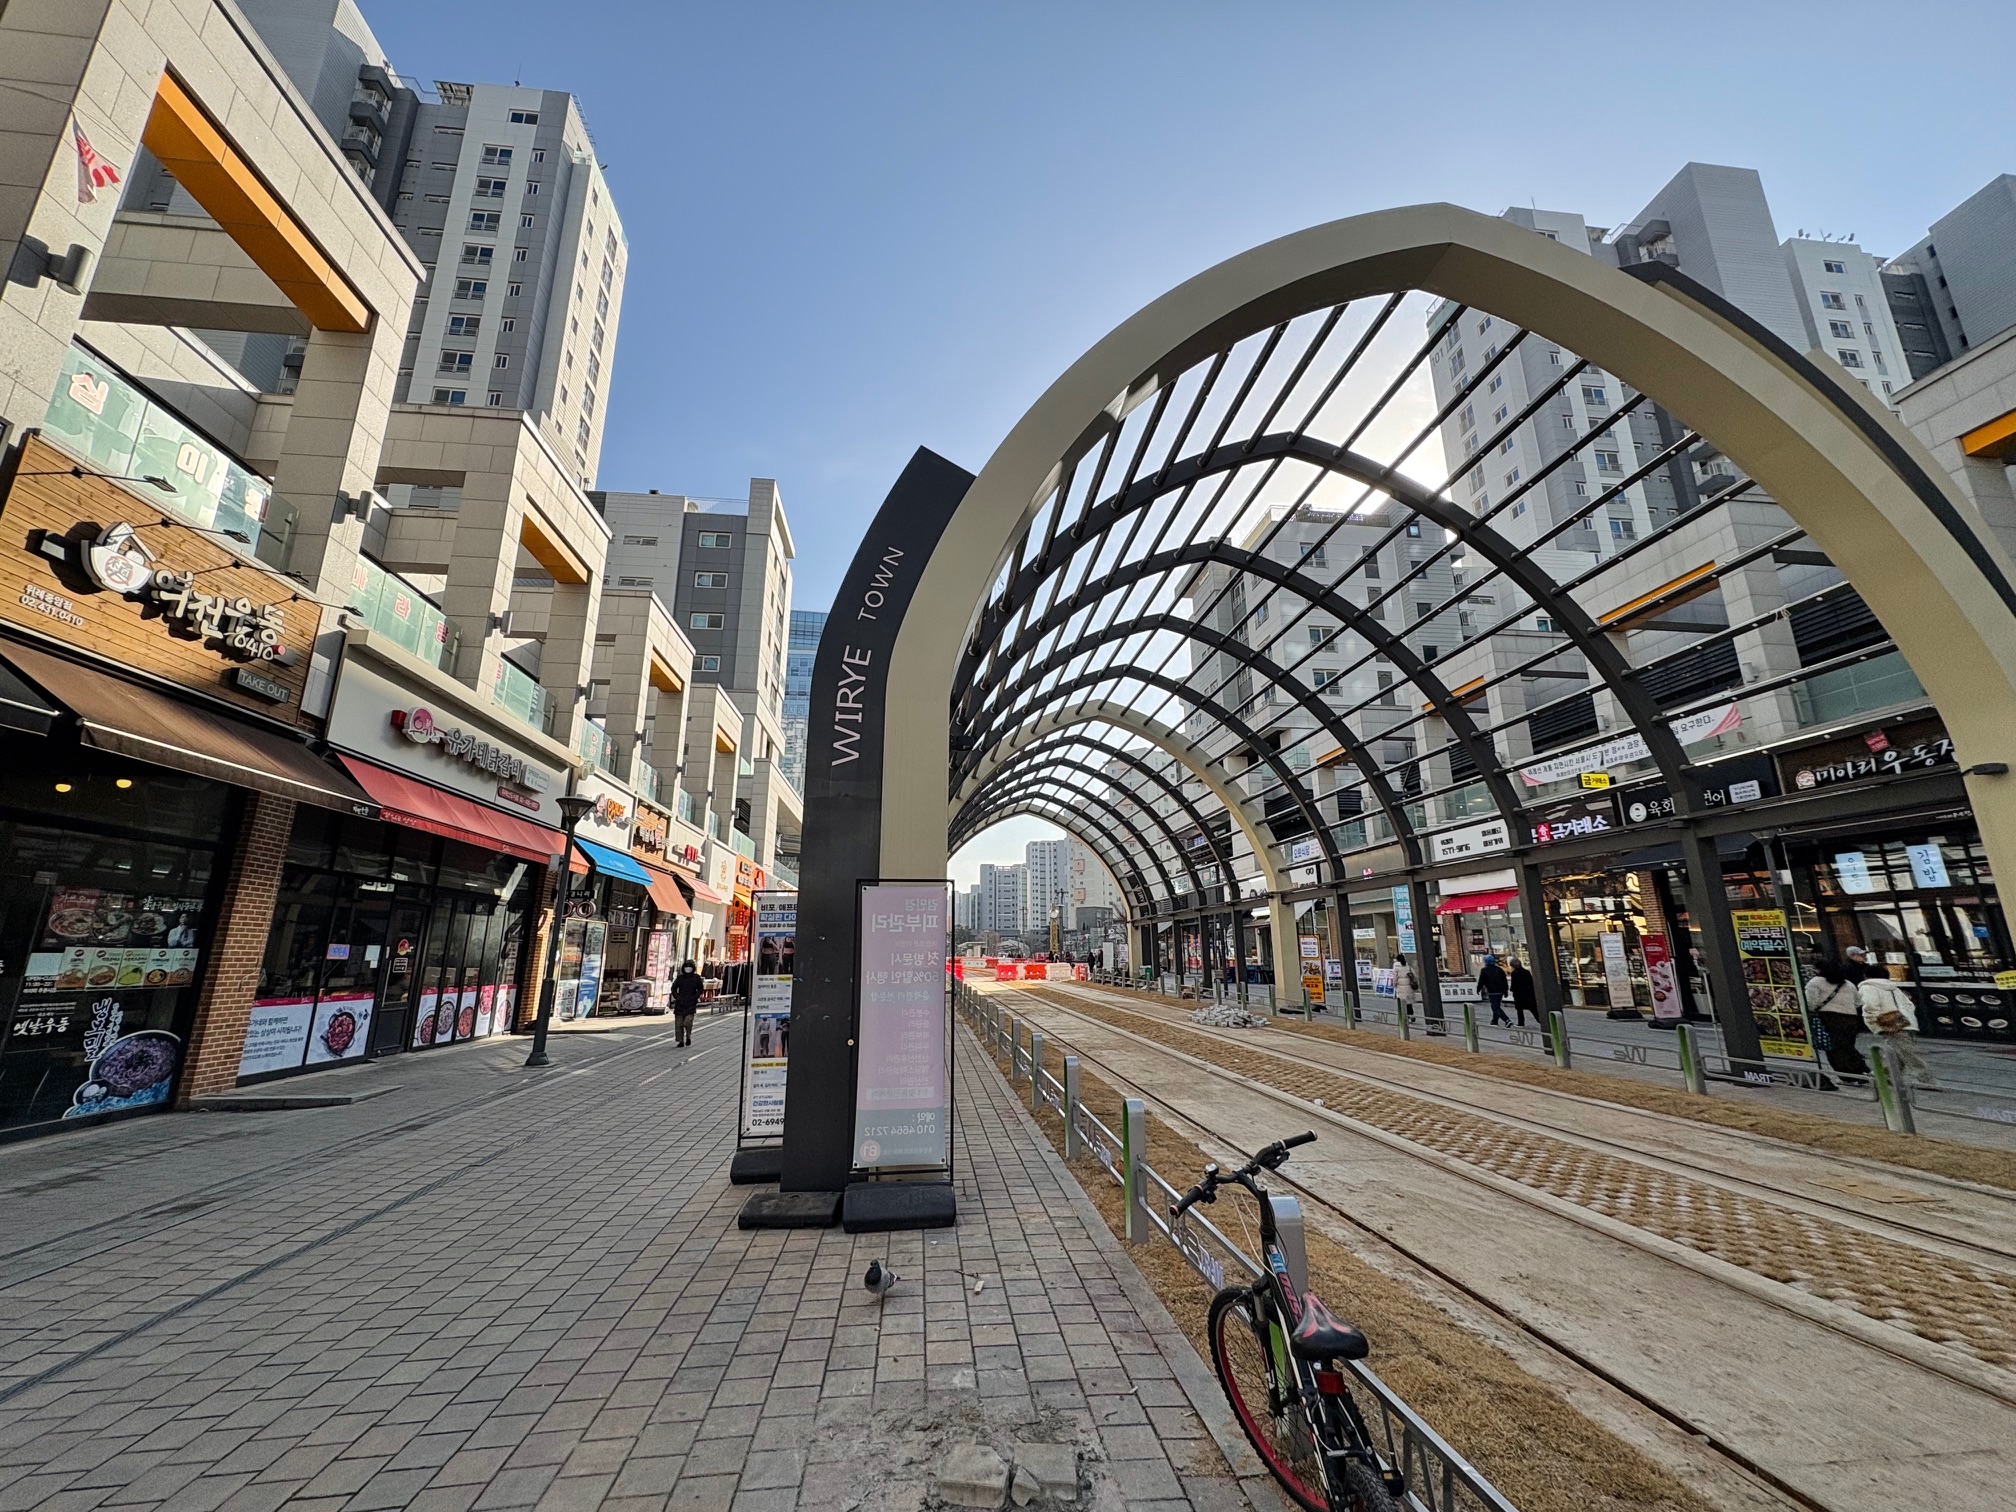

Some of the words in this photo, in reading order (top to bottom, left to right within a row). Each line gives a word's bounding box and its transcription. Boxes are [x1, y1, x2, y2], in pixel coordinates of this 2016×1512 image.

[857, 546, 904, 620] TOWN
[25, 584, 73, 611] 위례중앙점
[233, 634, 275, 661] 0410
[240, 671, 266, 691] TAKE
[267, 684, 287, 699] OUT
[831, 645, 872, 766] WIRYE
[448, 727, 523, 784] 유가네닭갈비
[1815, 757, 1877, 782] 미아리
[1647, 797, 1676, 817] 육회
[1550, 814, 1611, 840] 금거래소
